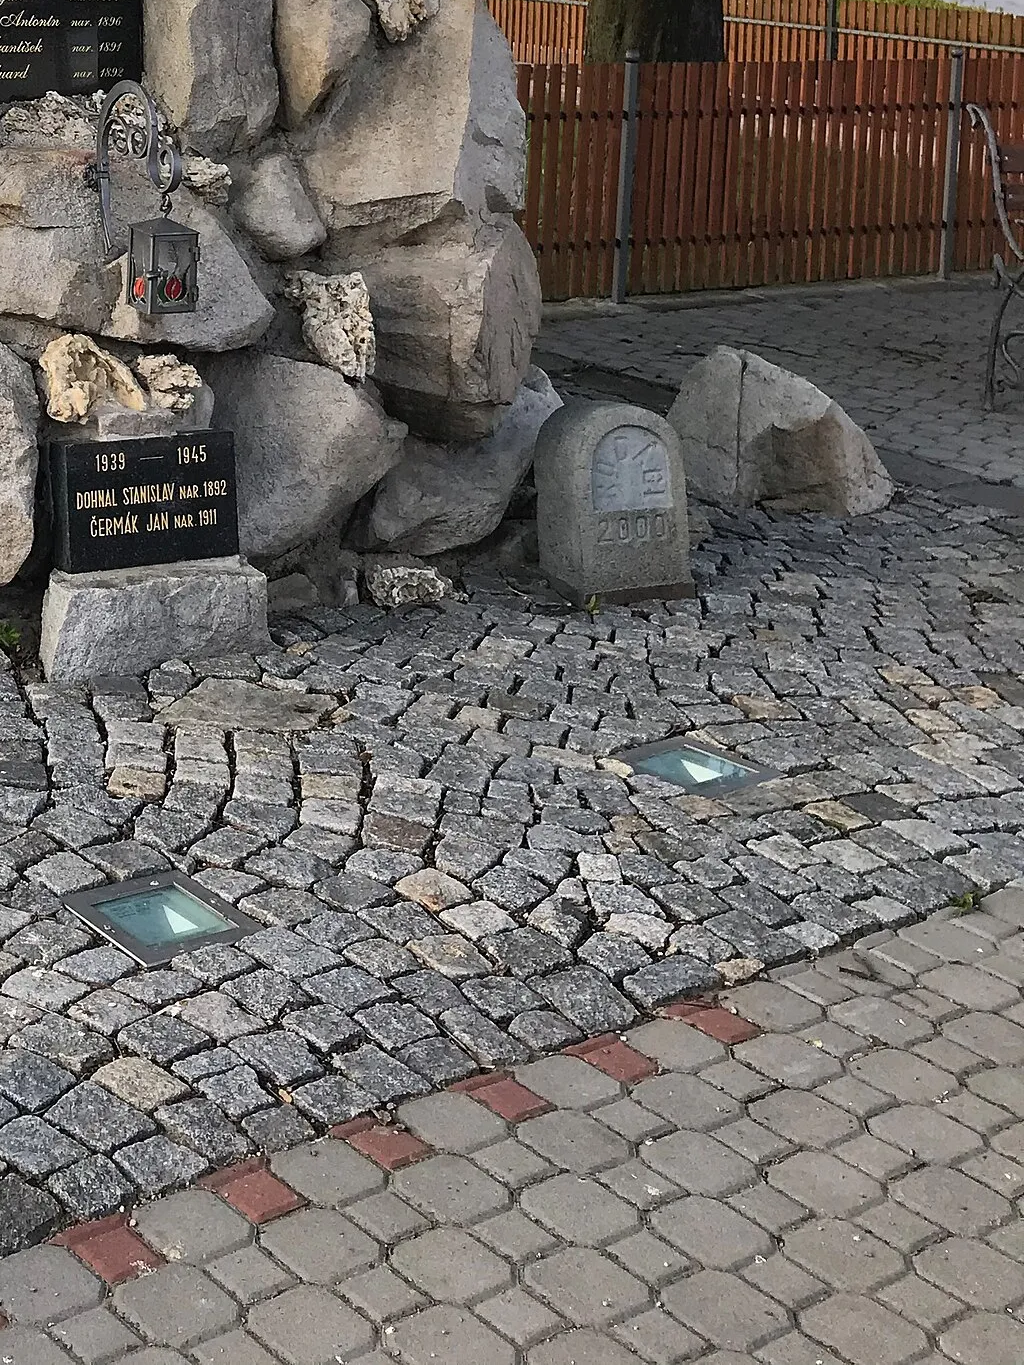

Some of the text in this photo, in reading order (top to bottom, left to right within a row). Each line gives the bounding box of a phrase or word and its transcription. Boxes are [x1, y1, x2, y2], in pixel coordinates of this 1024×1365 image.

[0, 10, 60, 28] Antonín
[70, 19, 92, 27] nar.
[97, 16, 123, 27] 1896
[71, 44, 94, 53] nar.
[98, 42, 123, 52] 1891
[73, 70, 95, 79] nar.
[99, 67, 125, 78] 1892
[95, 452, 126, 473] 1939
[177, 444, 207, 465] 1945
[76, 488, 118, 510] DOHNAL
[122, 482, 175, 506] STANISLAV
[90, 512, 139, 538] ČERMÁK
[146, 511, 169, 532] JAN
